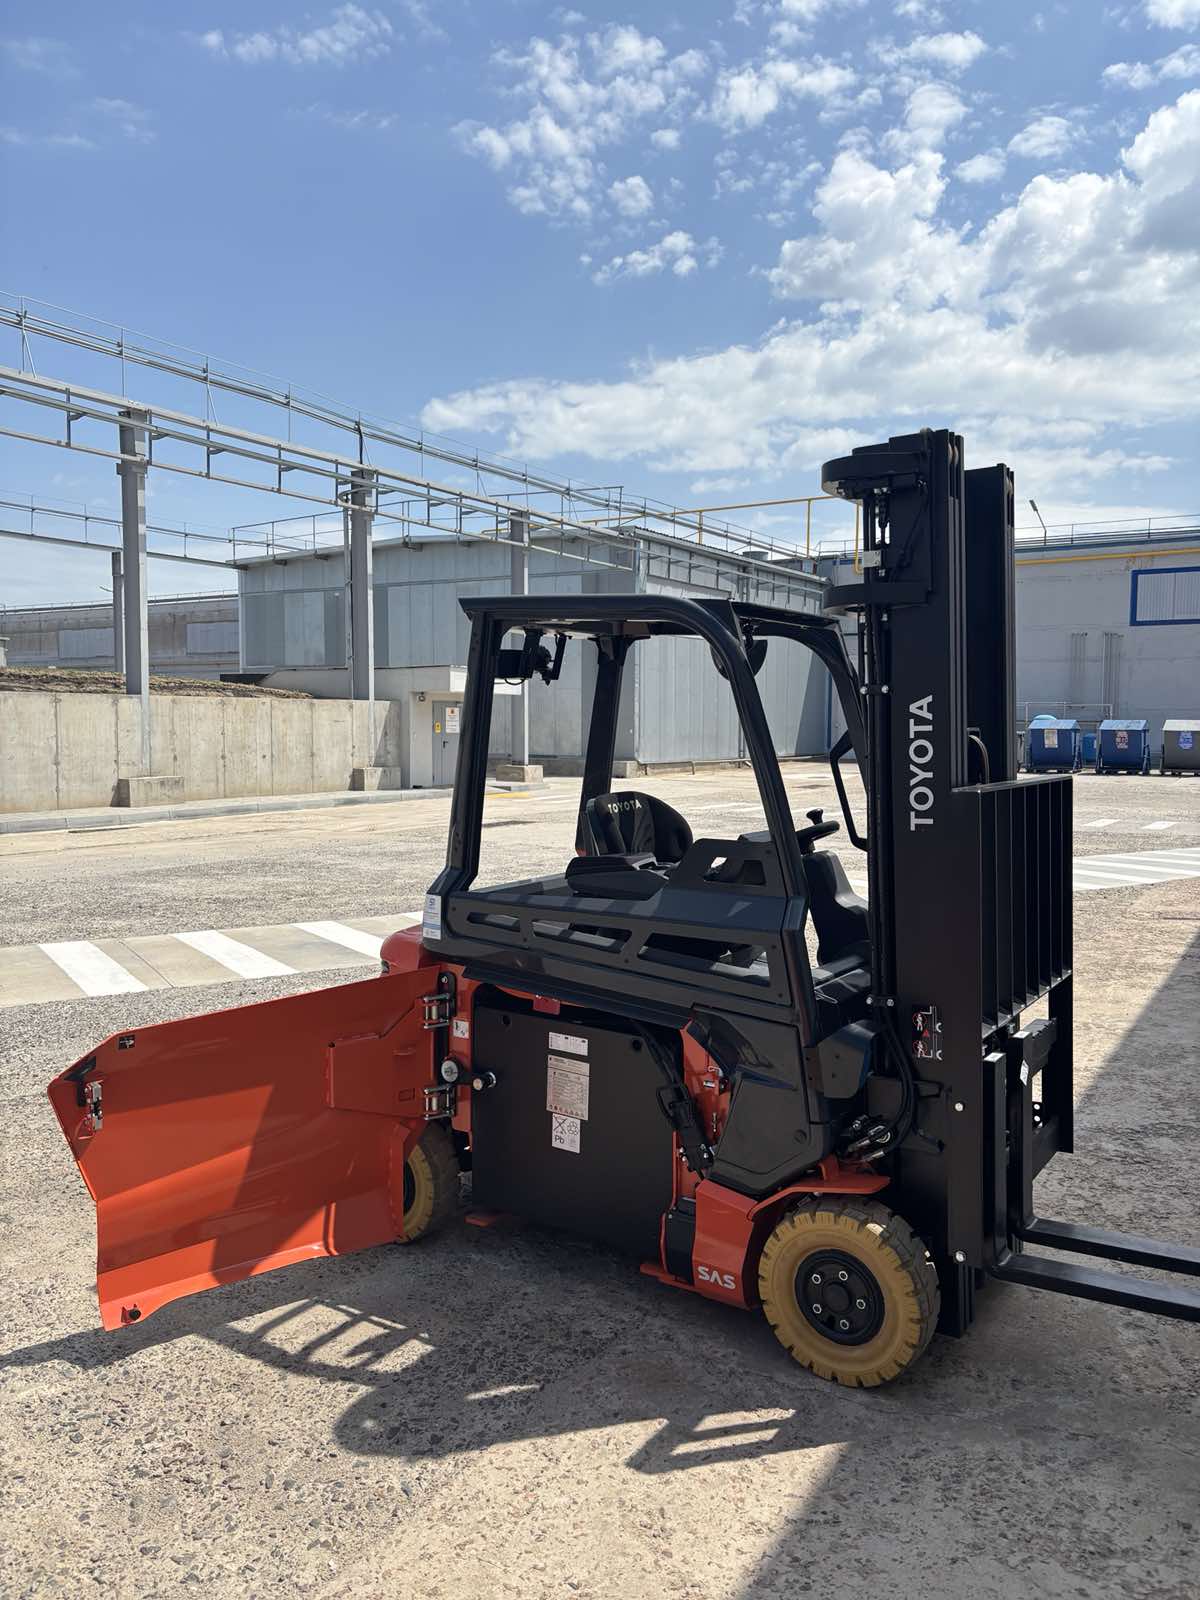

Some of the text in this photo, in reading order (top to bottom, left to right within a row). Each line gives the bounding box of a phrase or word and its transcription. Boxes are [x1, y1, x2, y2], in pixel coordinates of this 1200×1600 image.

[909, 695, 934, 831] TOYOTA
[608, 800, 642, 814] TOYOTA
[555, 1135, 564, 1144] Pb
[698, 1266, 736, 1290] SAS
